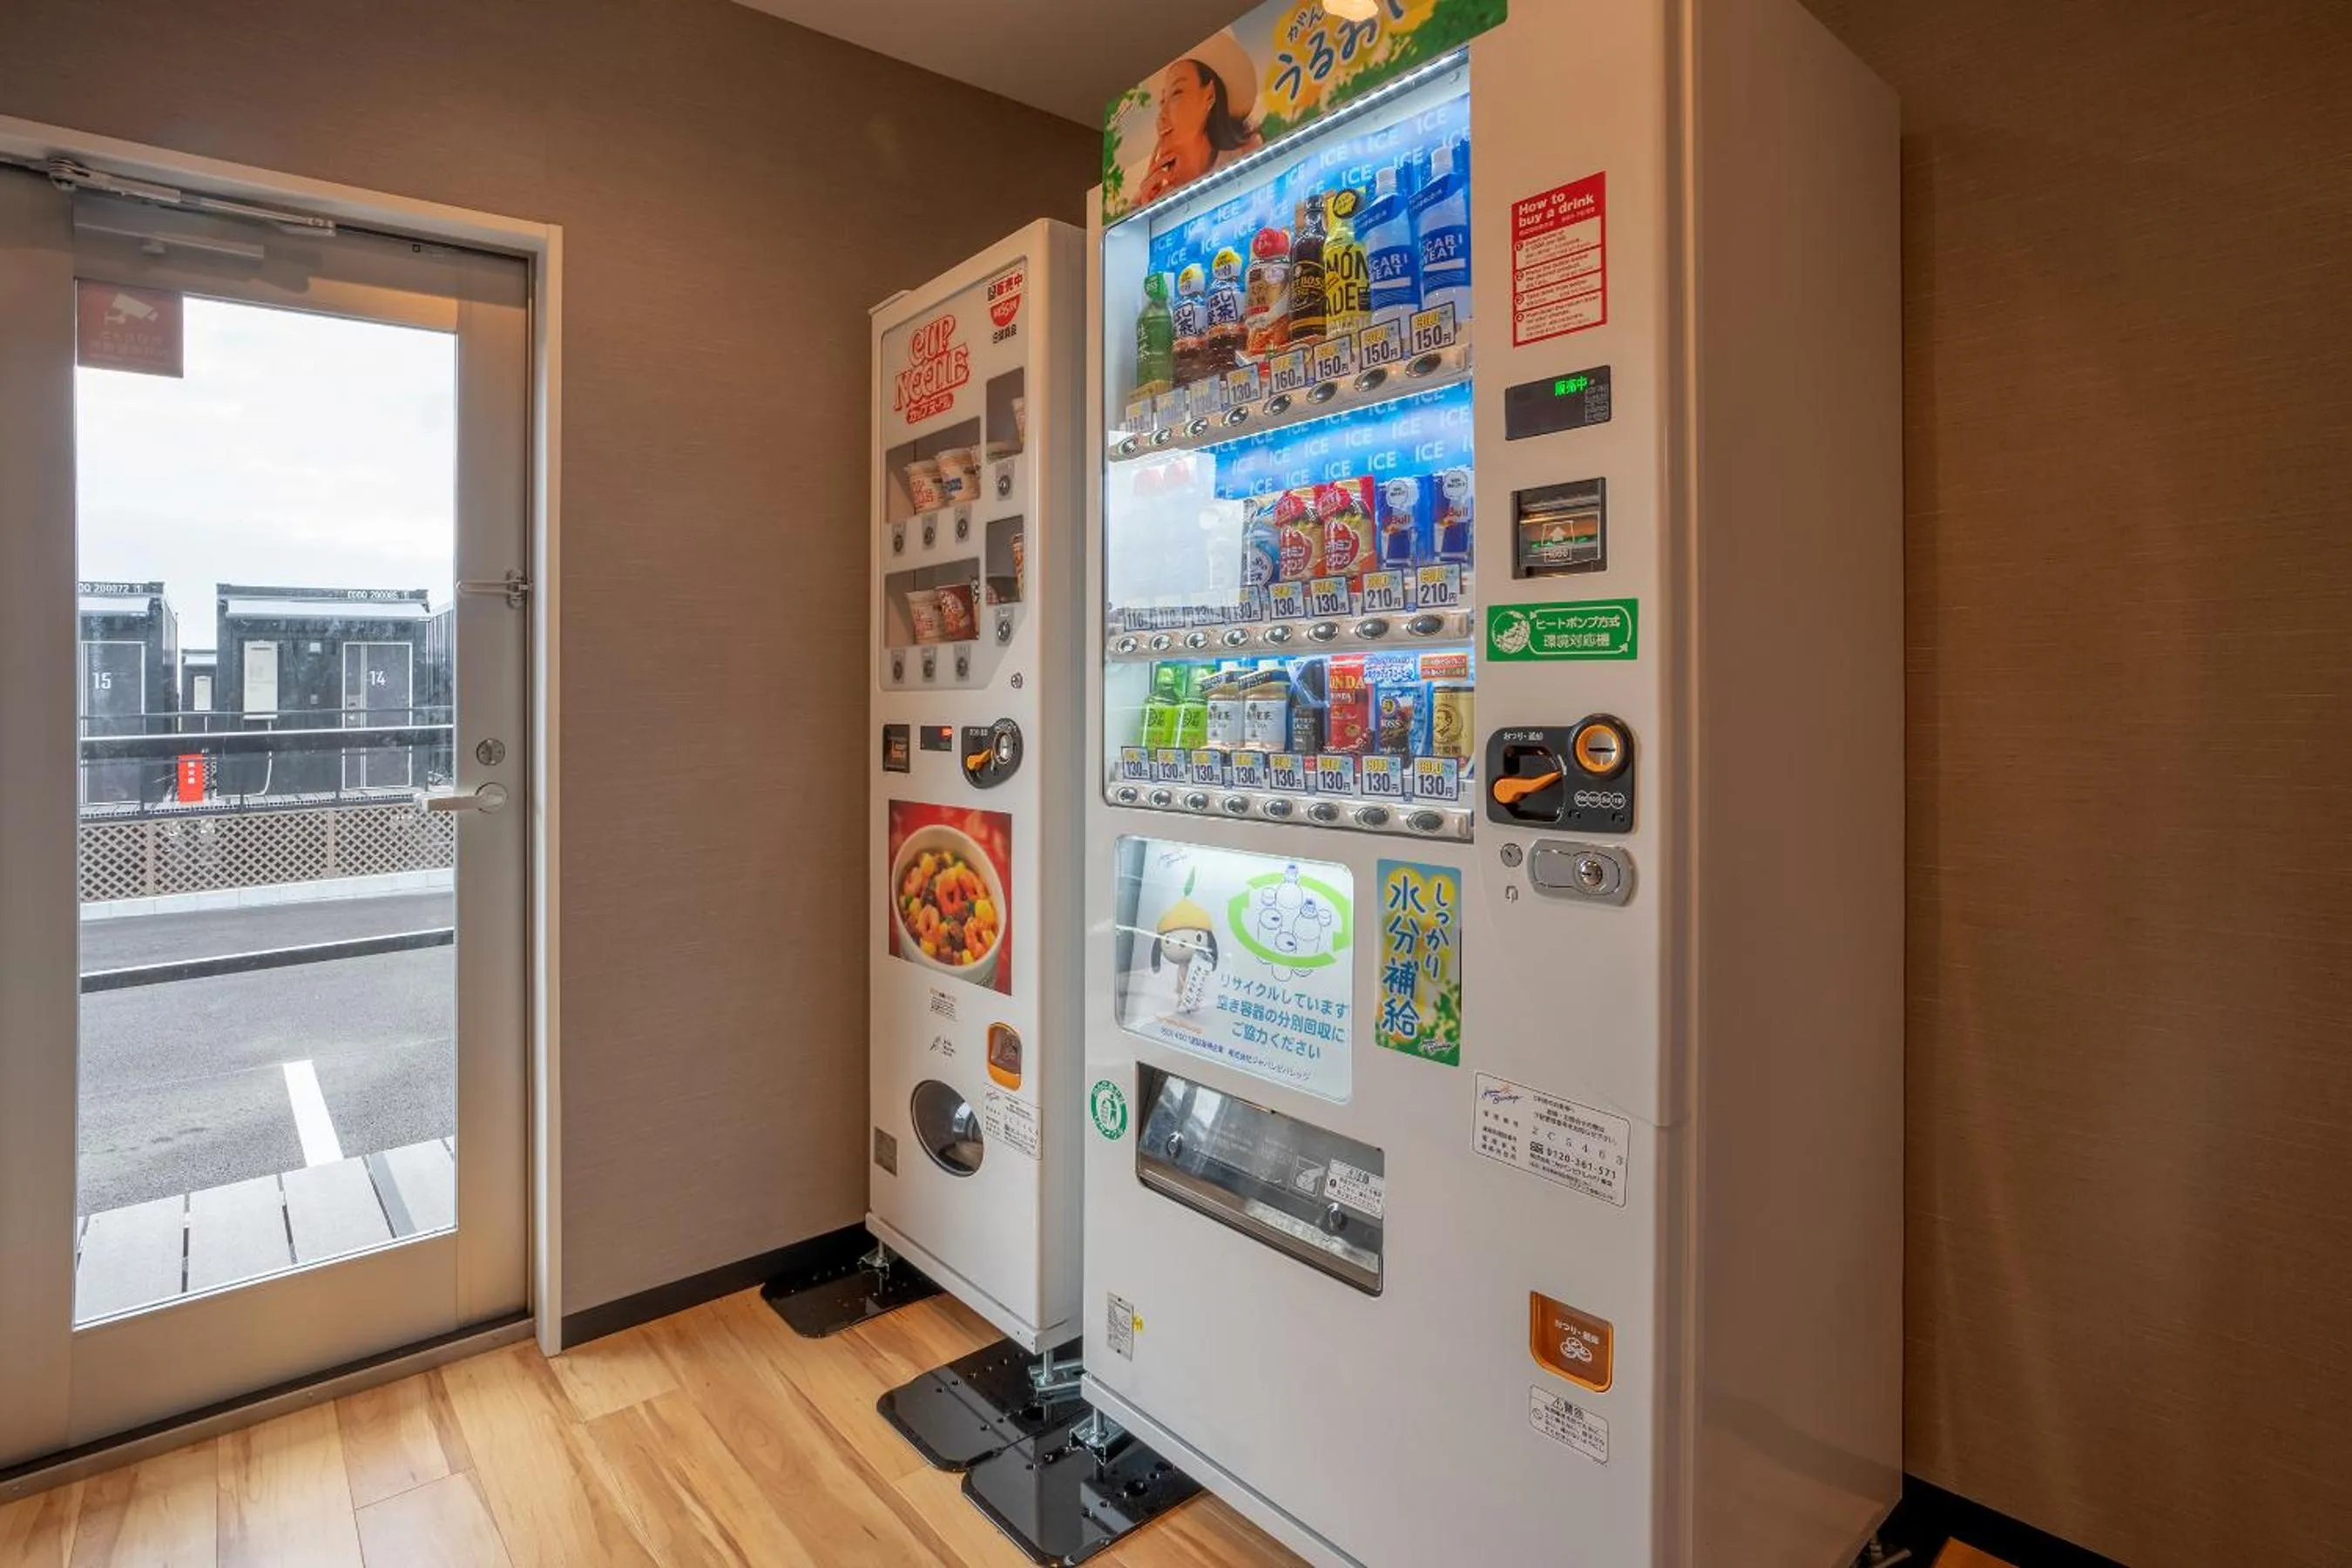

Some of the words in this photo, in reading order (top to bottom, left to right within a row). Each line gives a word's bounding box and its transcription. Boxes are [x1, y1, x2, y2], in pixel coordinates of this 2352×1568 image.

[1342, 165, 1373, 187] ICE
[1518, 198, 1547, 216] How
[1551, 192, 1565, 206] to
[1518, 214, 1542, 228] buy
[1558, 193, 1595, 214] drink
[1415, 324, 1451, 350] 150円
[1364, 341, 1398, 364] 150円
[1345, 428, 1373, 448] ICE
[1392, 417, 1423, 439] ICE
[1368, 451, 1397, 472] ICE
[1415, 441, 1445, 463] ICE
[1420, 583, 1457, 605] 210円
[1536, 615, 1620, 630] ヒートポンプ方式
[92, 672, 112, 689] 15
[369, 670, 387, 686] 14
[1274, 769, 1303, 788] 130円
[1320, 772, 1351, 791] 130円
[1366, 774, 1400, 794] 130円
[1418, 774, 1454, 797] 130円
[1425, 882, 1450, 978] しっかり
[1382, 875, 1426, 1036] 水分補給
[1220, 973, 1349, 1018] リサイクルしています
[1216, 994, 1346, 1043] 空き容器の分別回収に
[1232, 1021, 1321, 1059] ご協力ください
